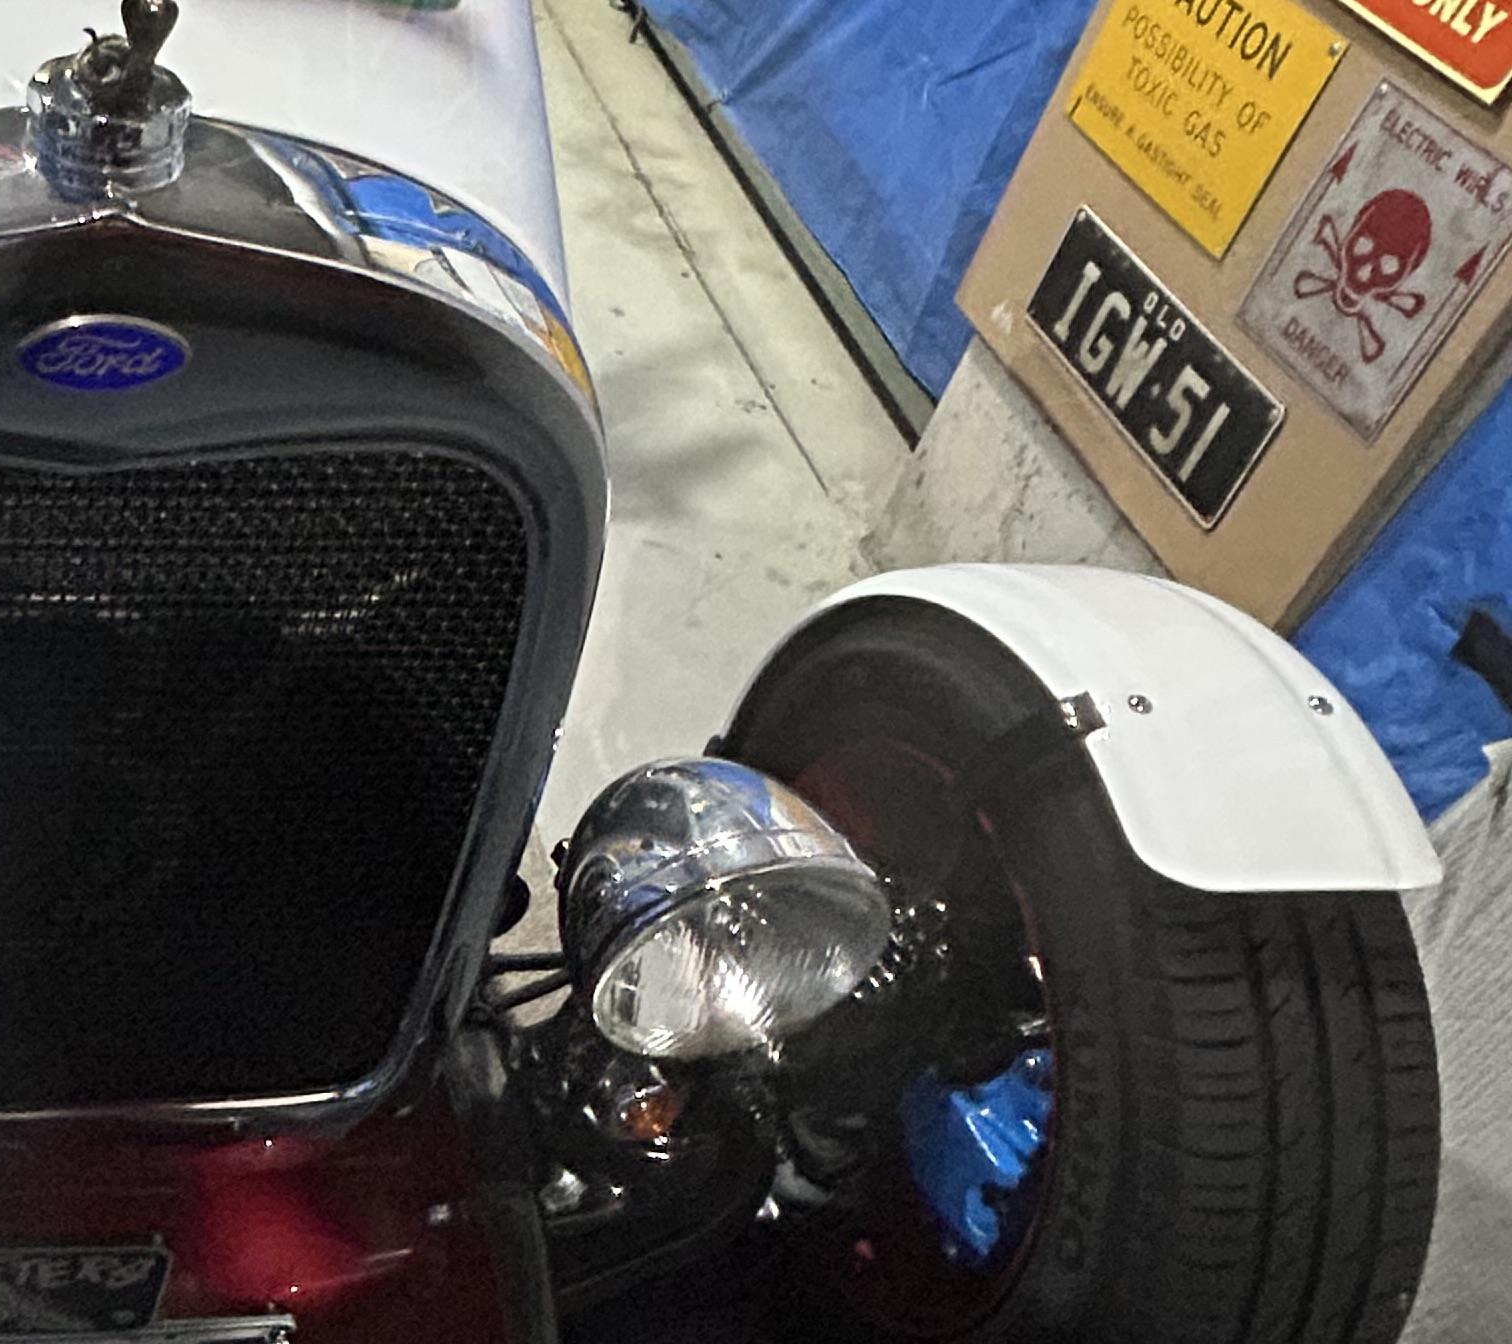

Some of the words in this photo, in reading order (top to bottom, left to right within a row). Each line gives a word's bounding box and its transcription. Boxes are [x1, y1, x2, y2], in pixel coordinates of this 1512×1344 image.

[1122, 5, 1233, 107] POSSIBILITY
[1236, 101, 1271, 134] OF
[1125, 56, 1180, 117] TOXIC
[1183, 111, 1226, 157] GAS
[1380, 107, 1453, 172] ELECTRIC
[36, 333, 164, 378] Ford
[1281, 316, 1352, 385] DANGER
